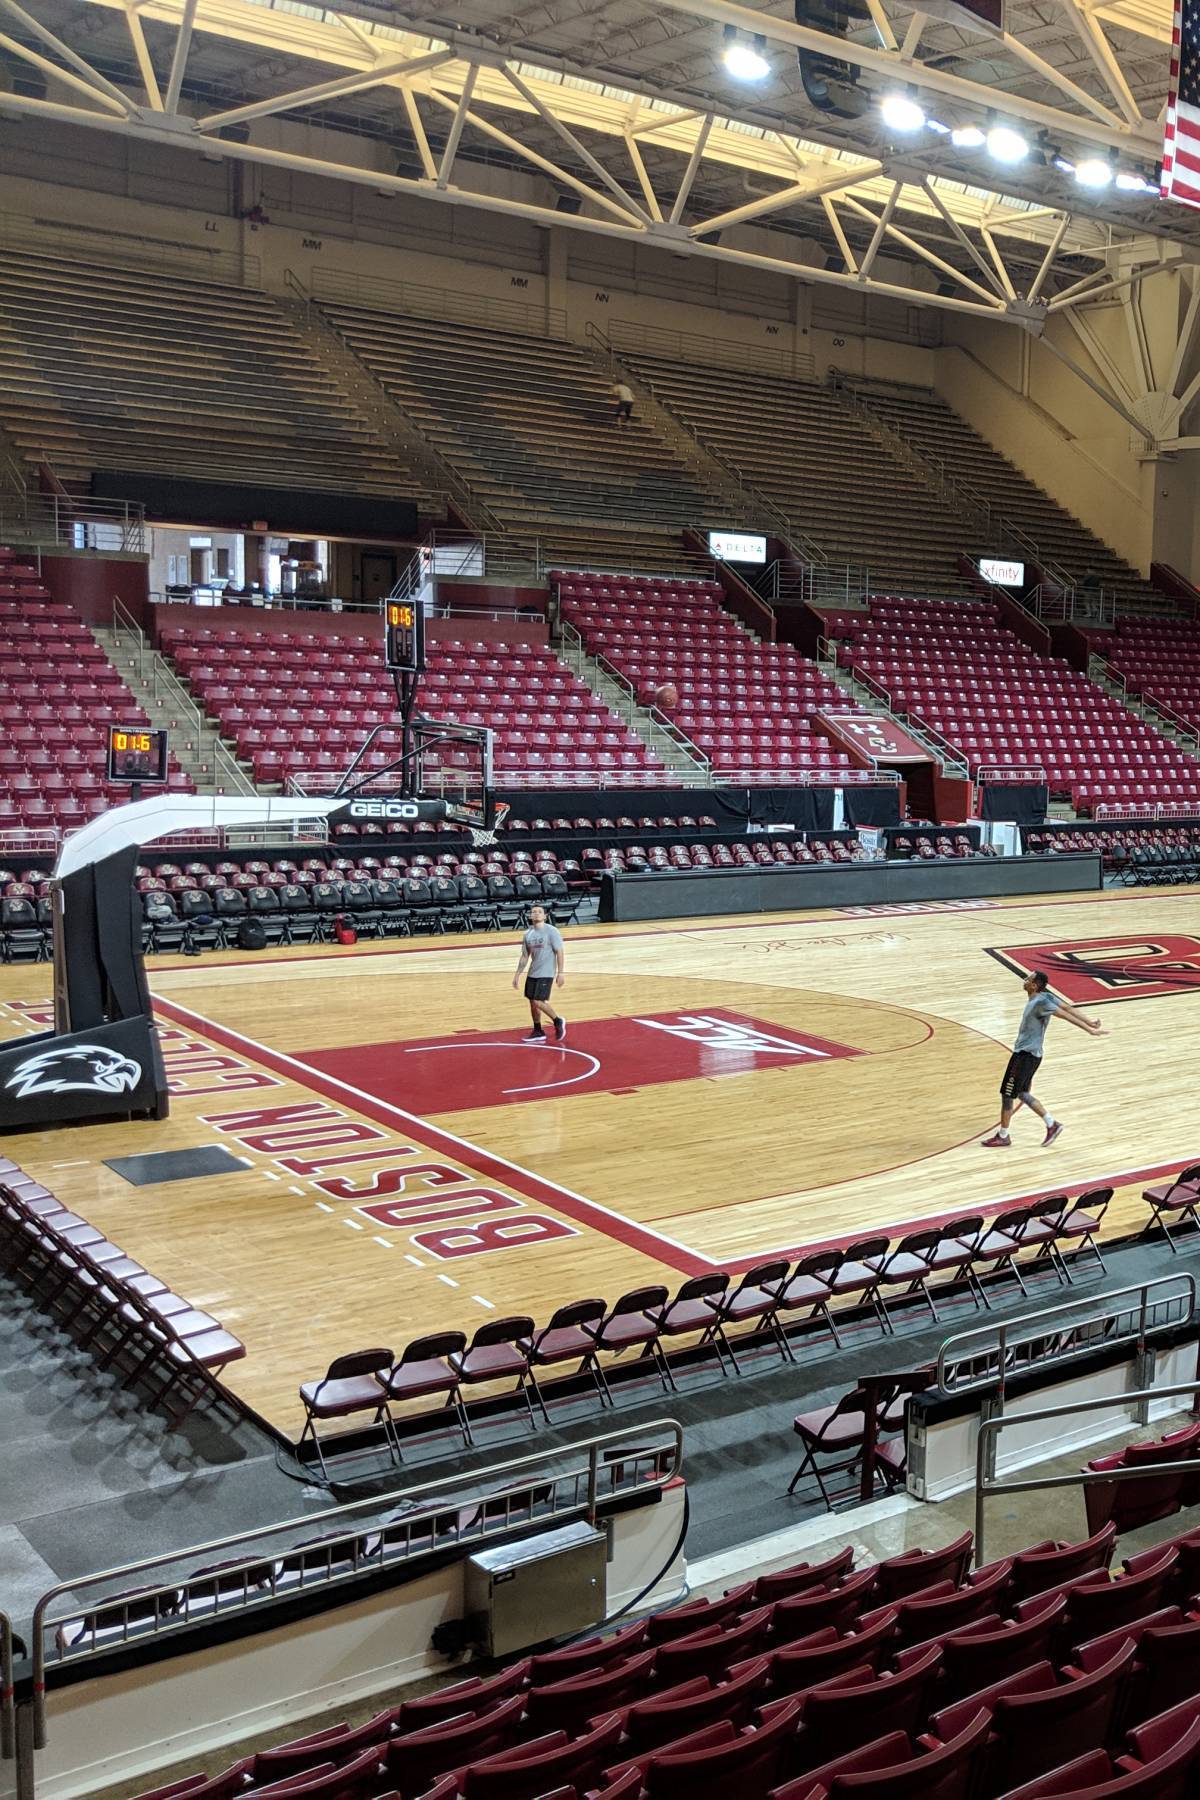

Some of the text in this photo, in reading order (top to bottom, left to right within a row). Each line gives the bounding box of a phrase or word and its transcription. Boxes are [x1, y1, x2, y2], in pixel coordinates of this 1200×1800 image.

[726, 543, 763, 553] DELTA
[985, 564, 1019, 581] xfinity
[350, 803, 419, 818] GEICO
[196, 1101, 583, 1261] BOSTON
